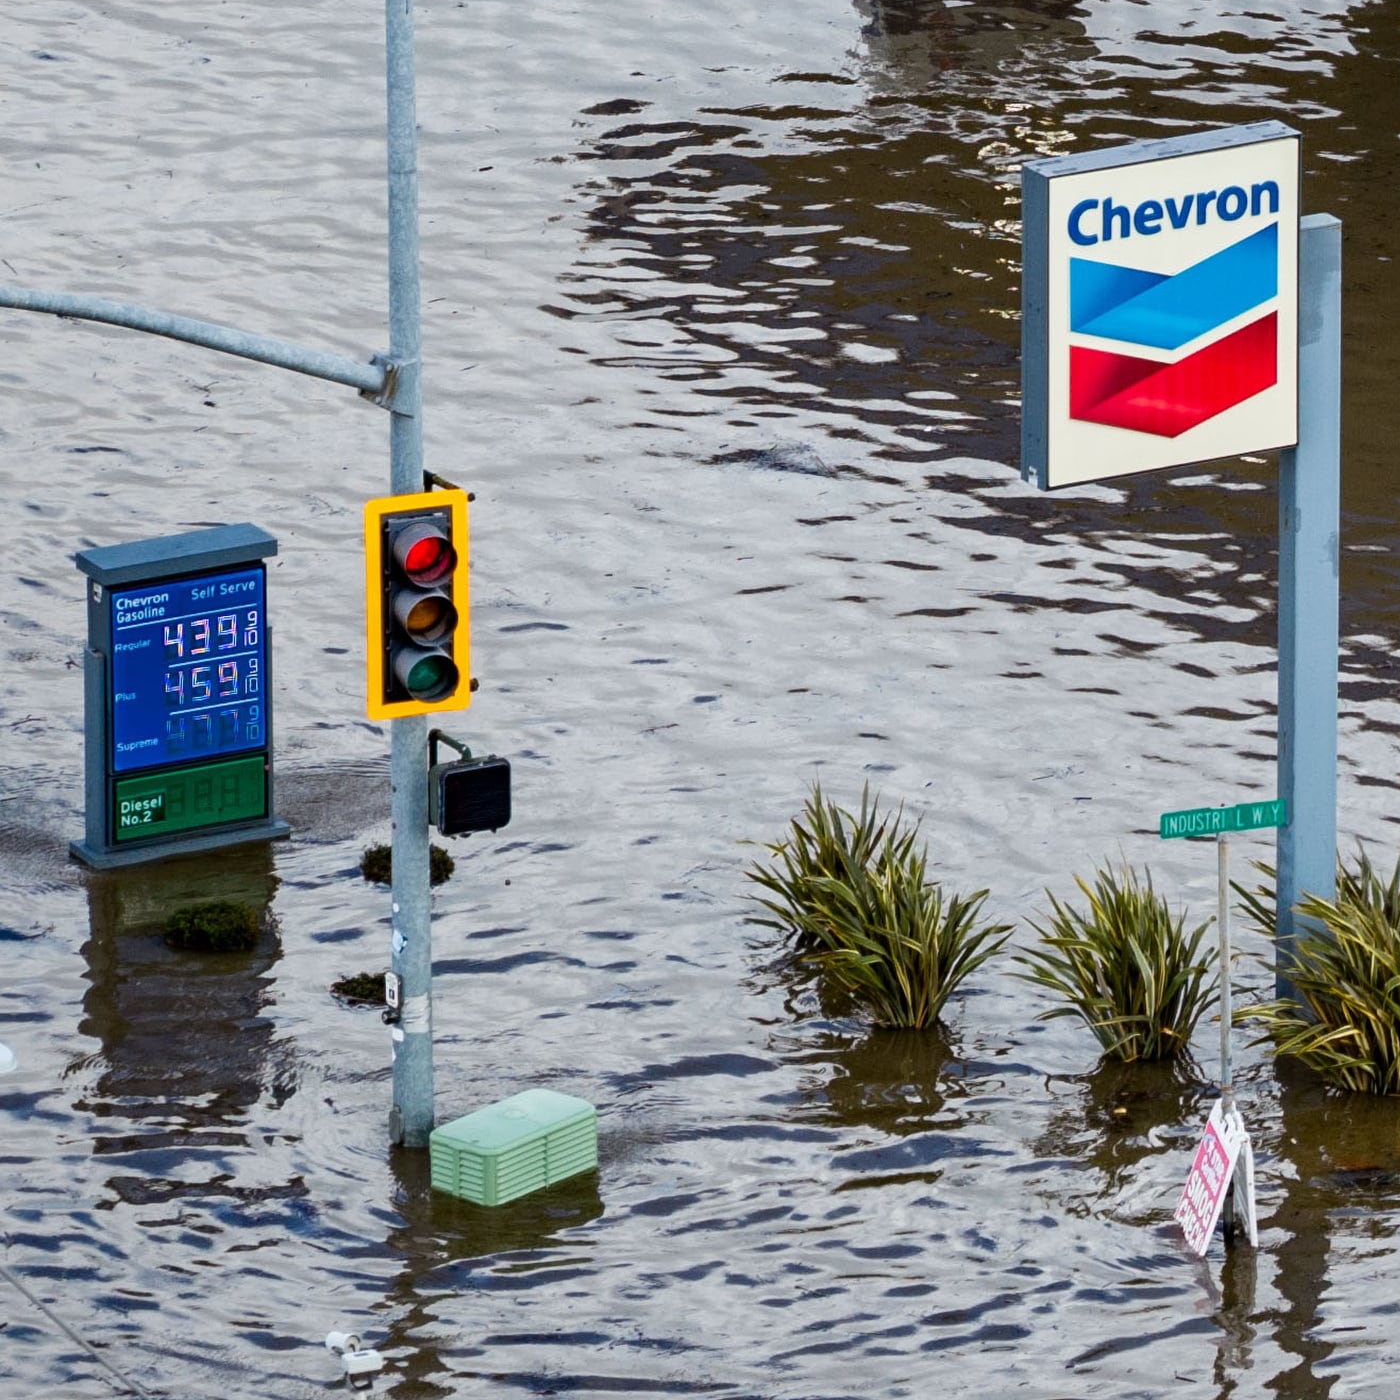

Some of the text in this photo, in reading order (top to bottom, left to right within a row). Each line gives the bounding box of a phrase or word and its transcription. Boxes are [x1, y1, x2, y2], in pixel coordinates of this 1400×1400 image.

[1067, 179, 1280, 246] Chevron
[191, 580, 256, 600] Self Serve
[116, 592, 169, 611] Chevron
[117, 606, 165, 624] Gasoline
[164, 614, 237, 657] 439
[114, 638, 151, 654] Regular
[165, 662, 238, 704] 459
[115, 692, 136, 704] Plus
[117, 738, 159, 752] Supreme
[120, 795, 162, 814] Diesel
[1165, 803, 1280, 835] INDUSTRIL WY
[1187, 1170, 1214, 1230] SMOG
